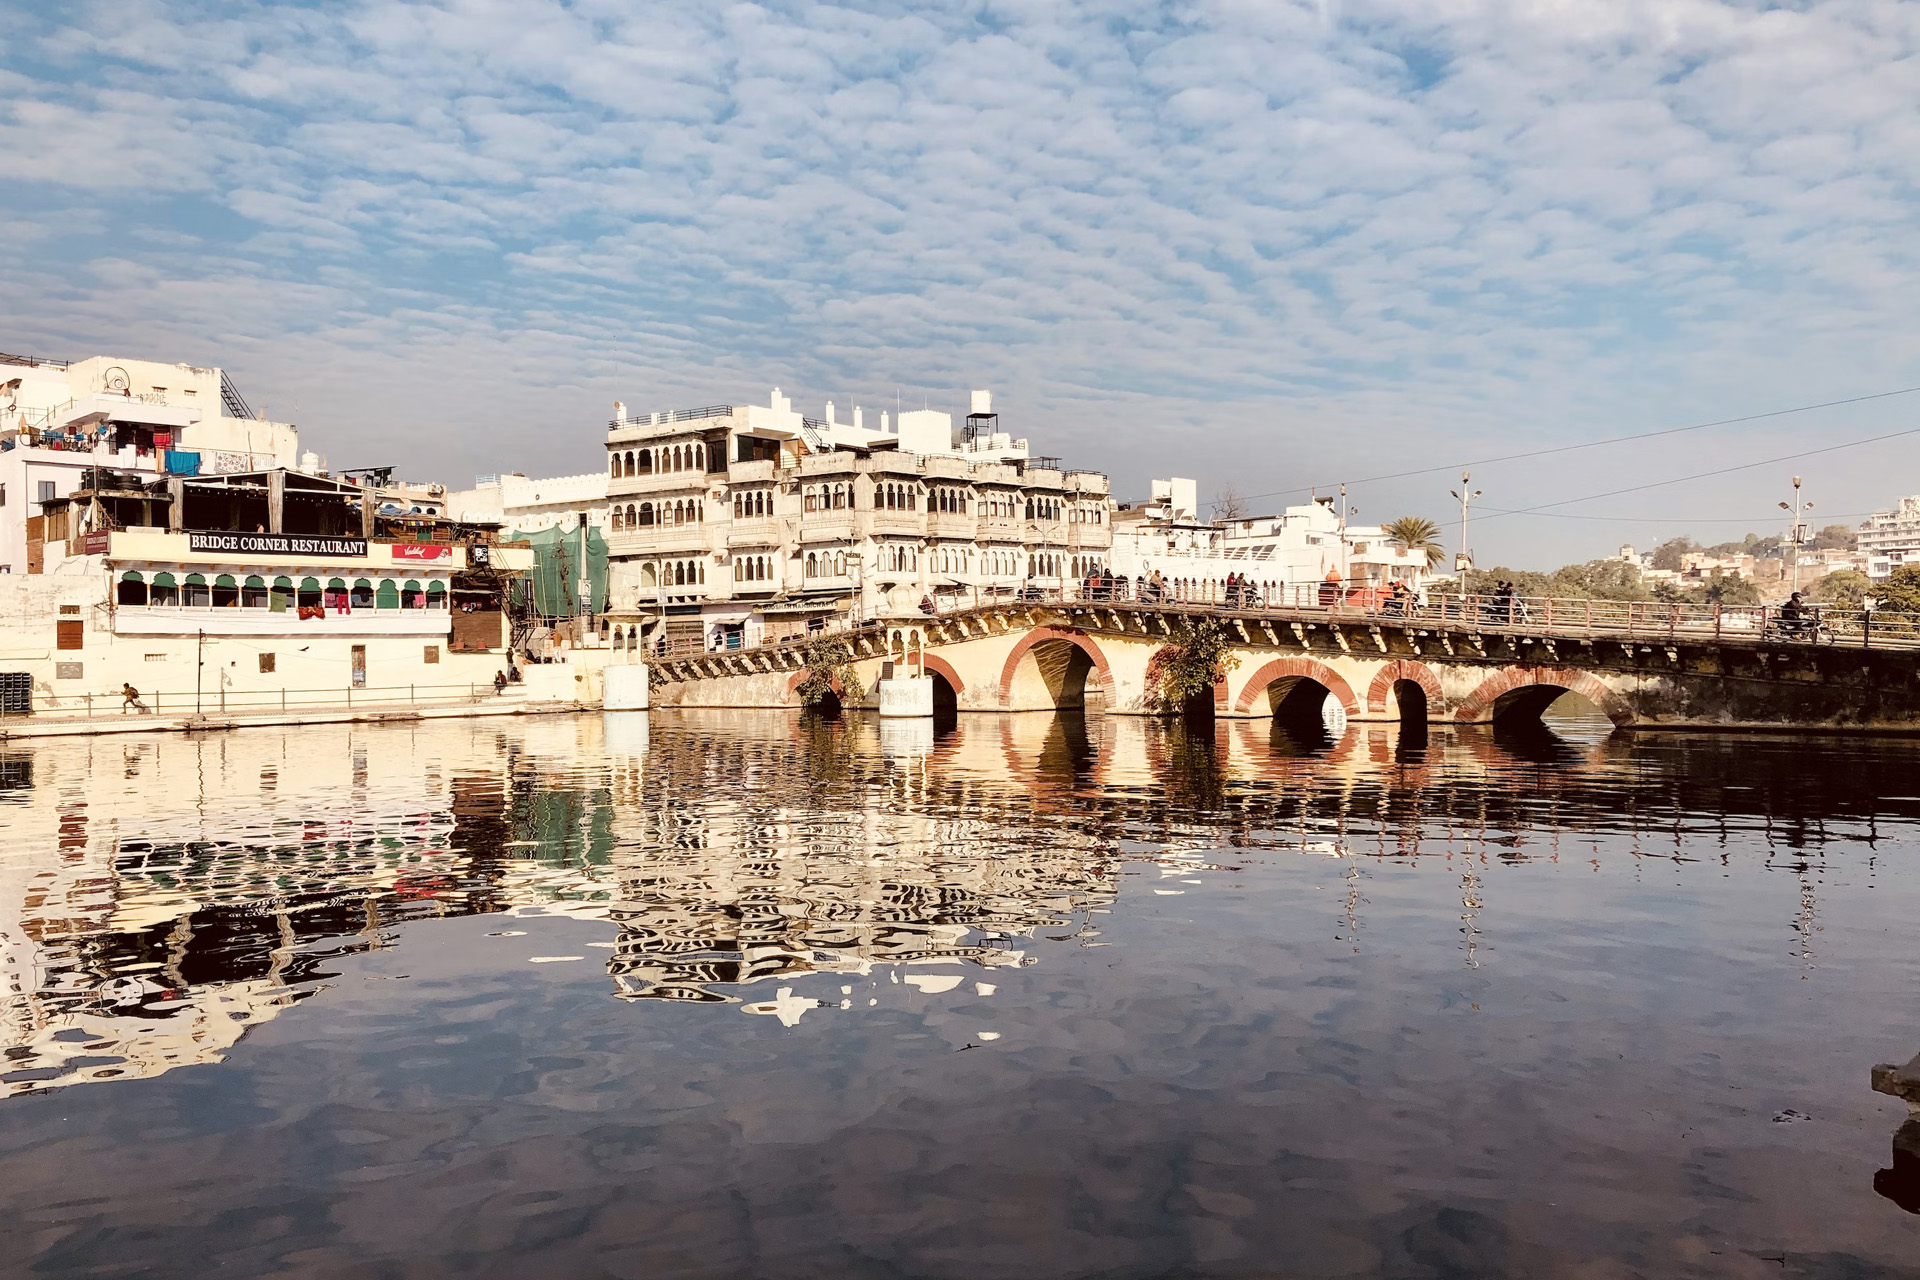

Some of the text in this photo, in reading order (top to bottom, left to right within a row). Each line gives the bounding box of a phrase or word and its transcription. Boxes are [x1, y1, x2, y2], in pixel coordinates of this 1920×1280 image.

[191, 534, 365, 554] BRIDGE CORNER RESTAURANT
